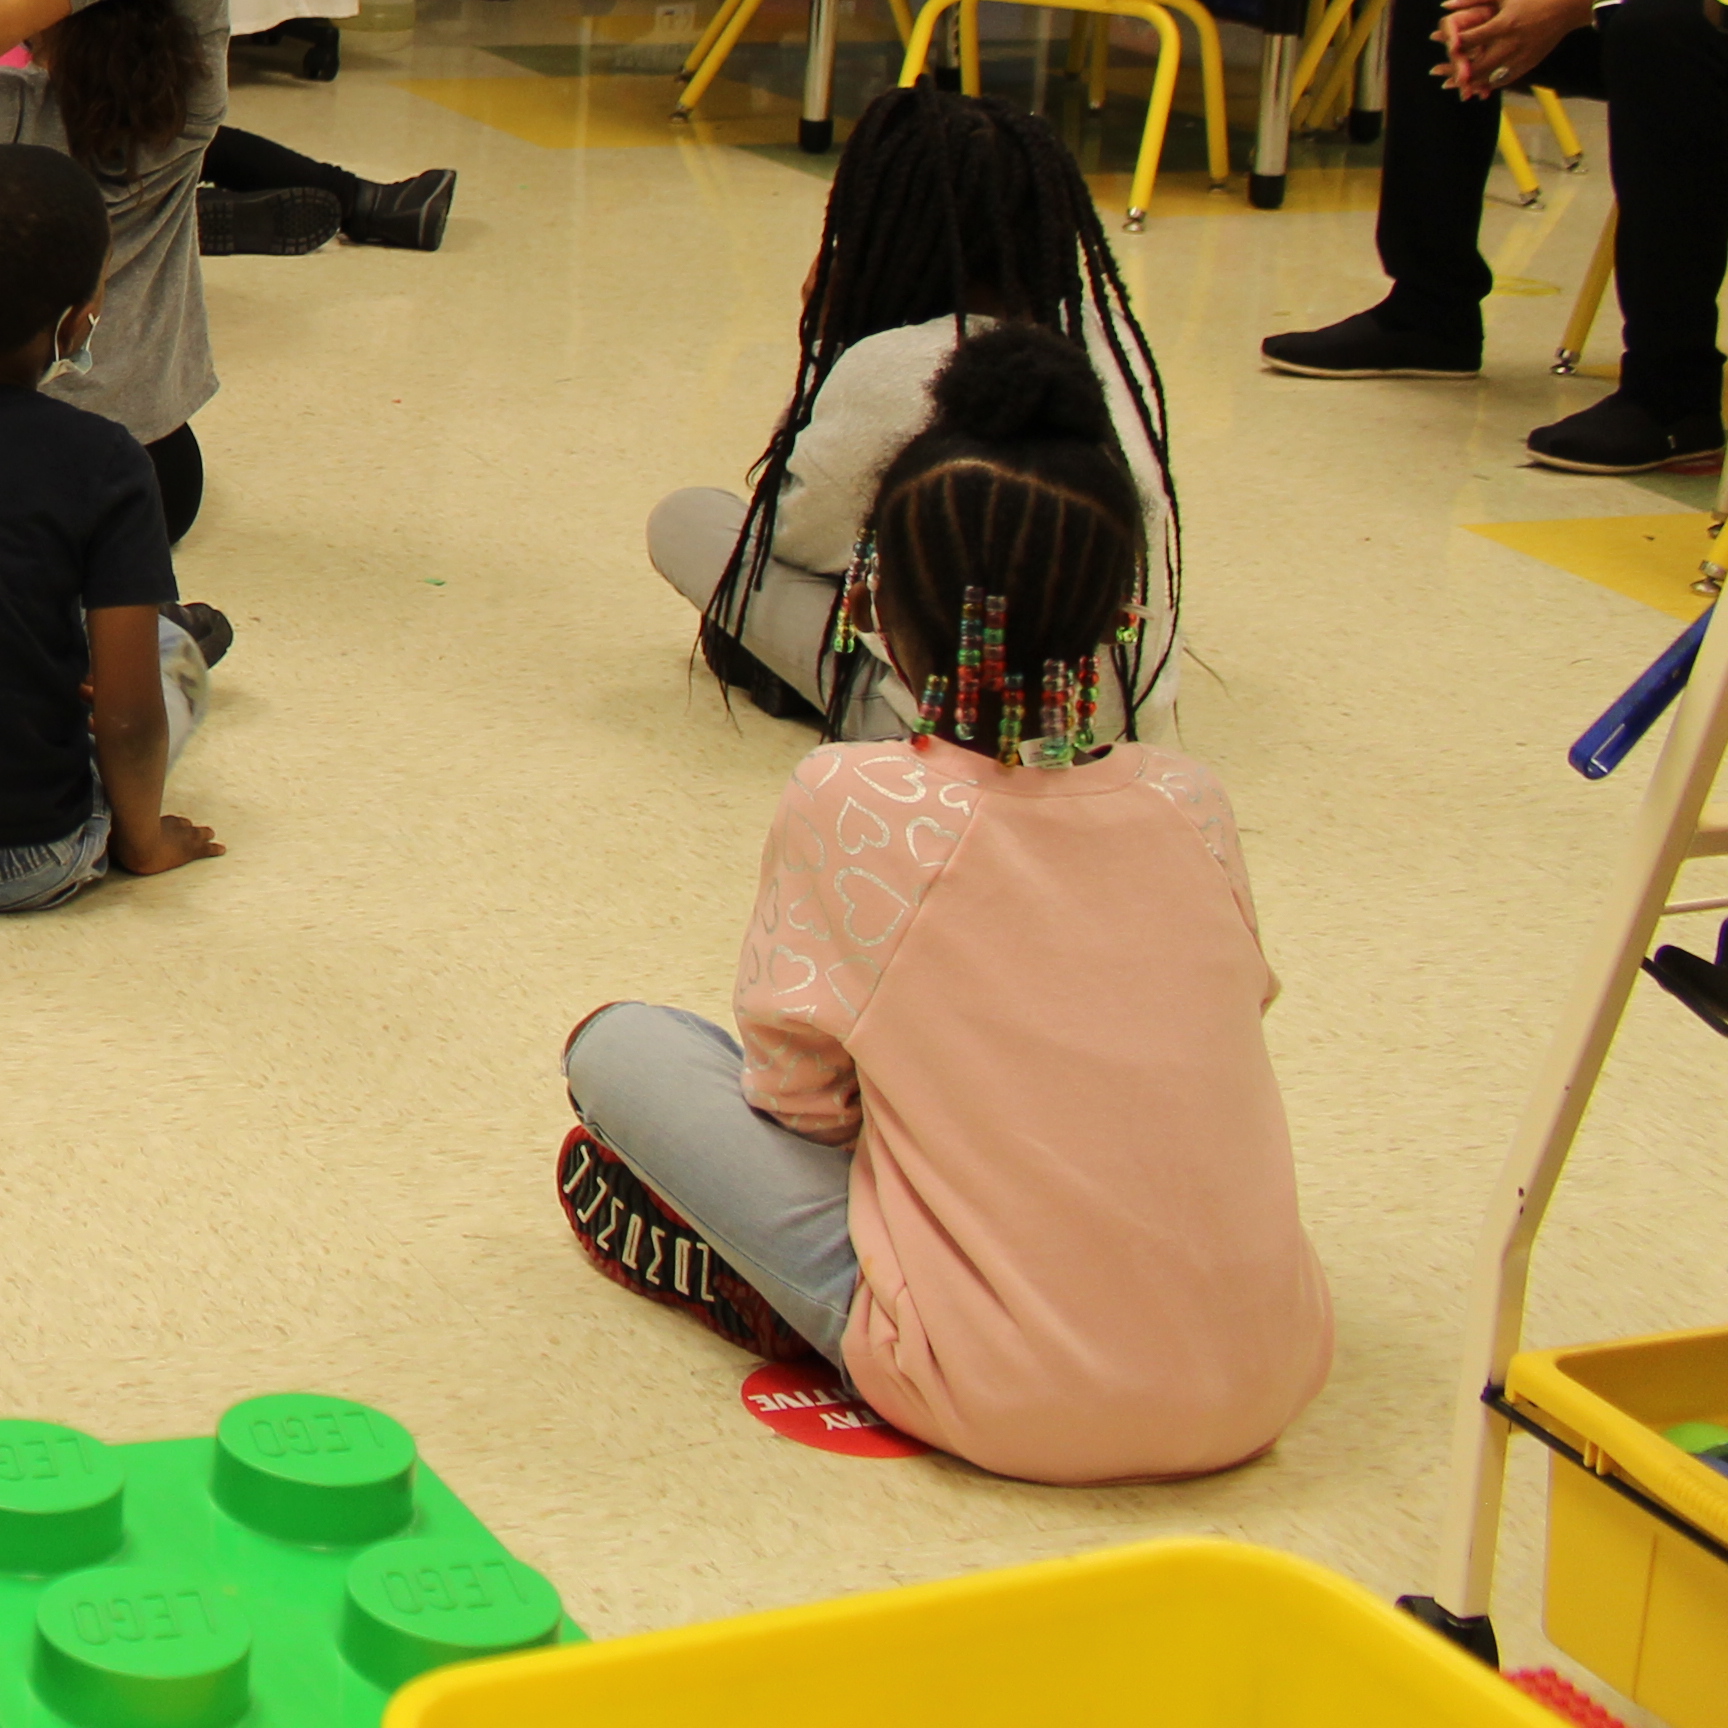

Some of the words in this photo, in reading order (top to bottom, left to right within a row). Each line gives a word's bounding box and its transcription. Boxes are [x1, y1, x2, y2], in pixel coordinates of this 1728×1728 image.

[747, 1388, 852, 1412] ITIVE
[819, 1410, 890, 1431] TAY
[248, 1410, 386, 1458] LEGO
[381, 1559, 531, 1615] LEGO
[70, 1590, 218, 1647] LEGO
